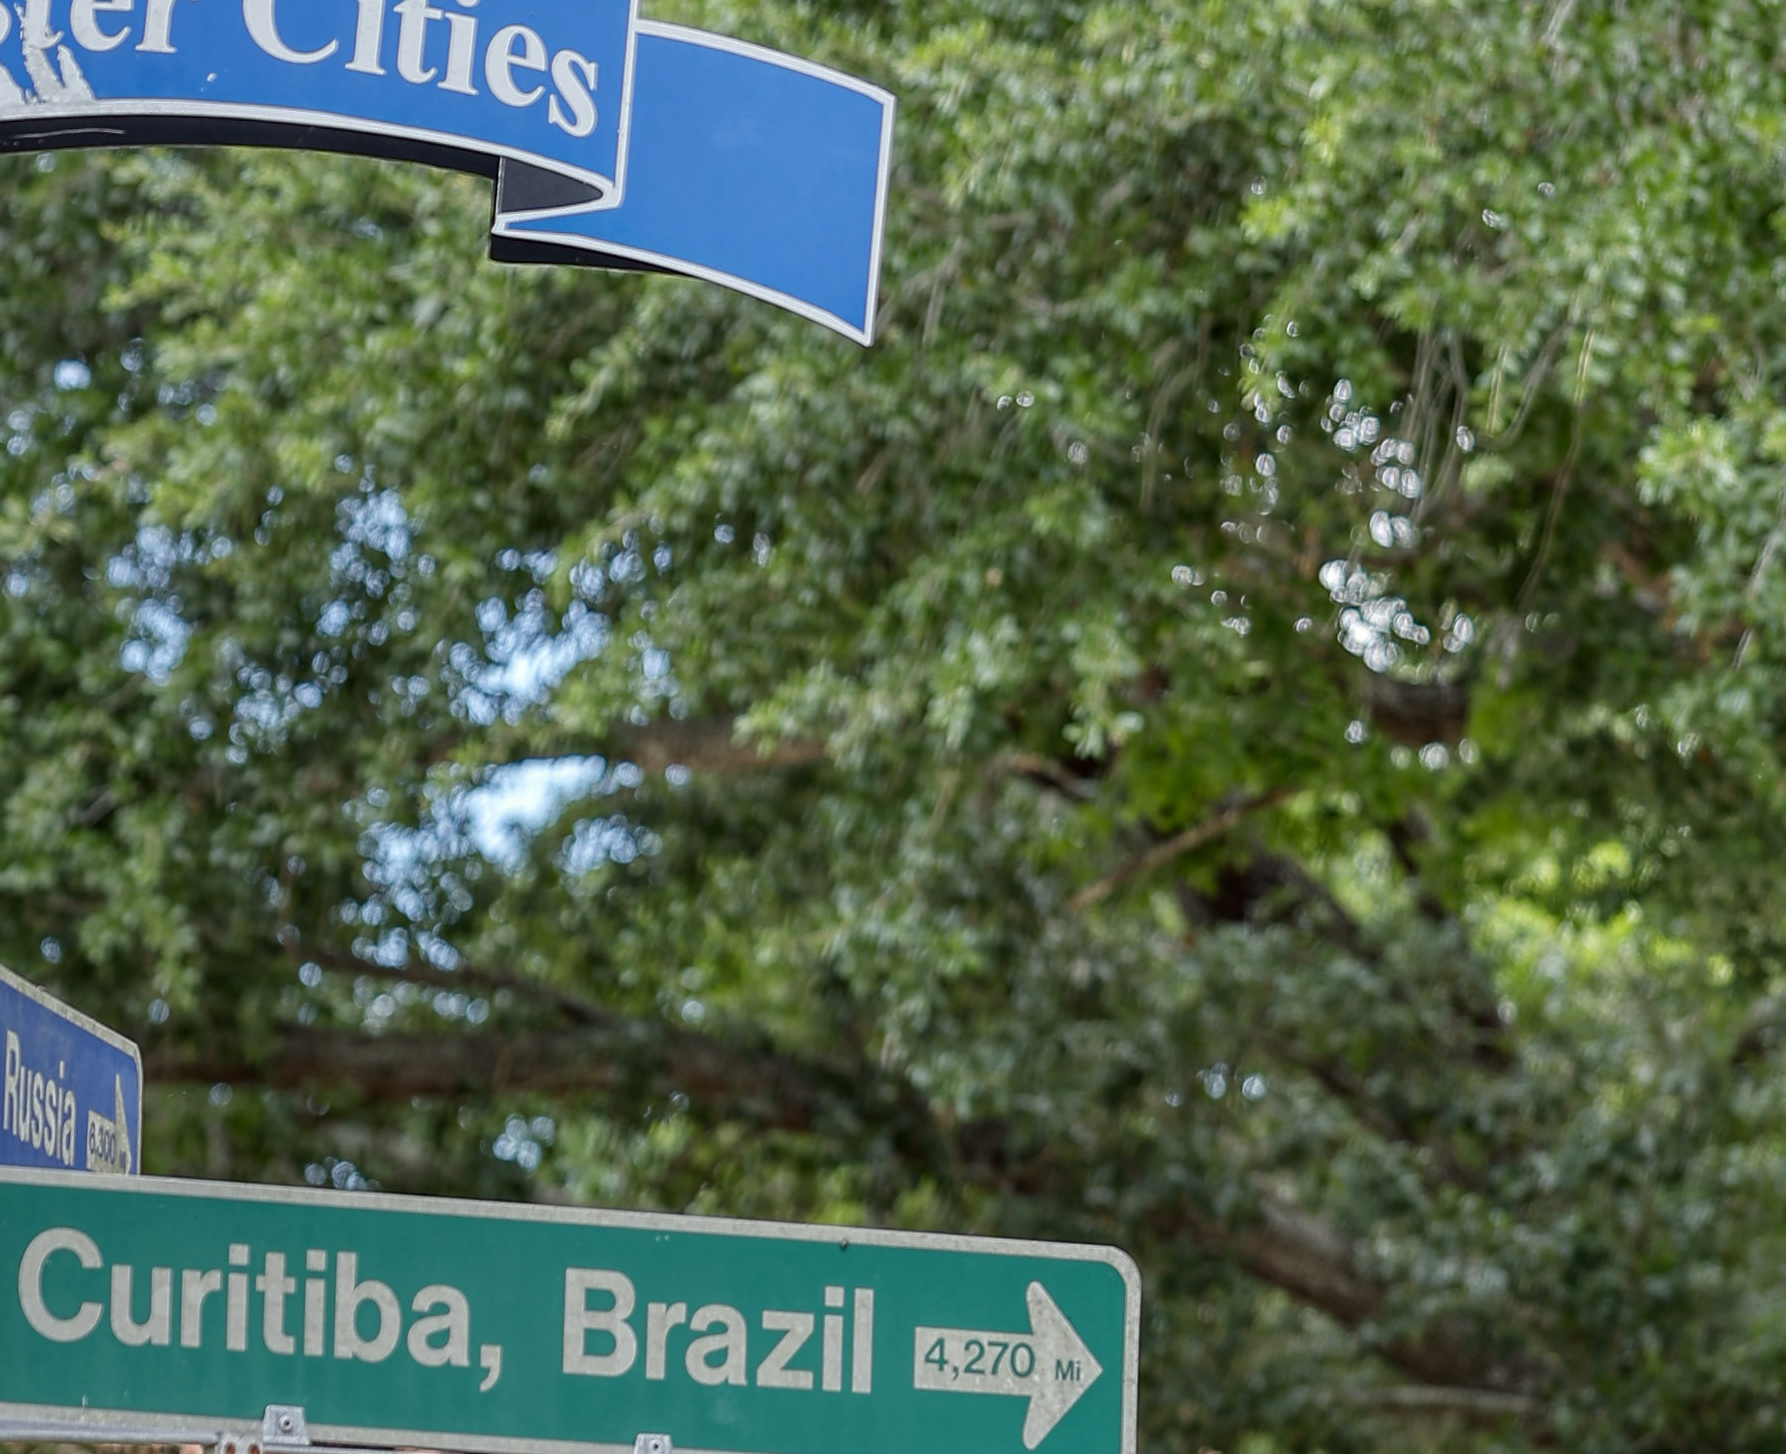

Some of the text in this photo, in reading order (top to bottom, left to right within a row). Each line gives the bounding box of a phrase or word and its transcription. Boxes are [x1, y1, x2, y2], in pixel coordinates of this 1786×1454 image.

[3, 1029, 76, 1166] Russia
[17, 1226, 876, 1394] Curitiba, Brazil
[924, 1337, 1082, 1382] 4,270 Mi
